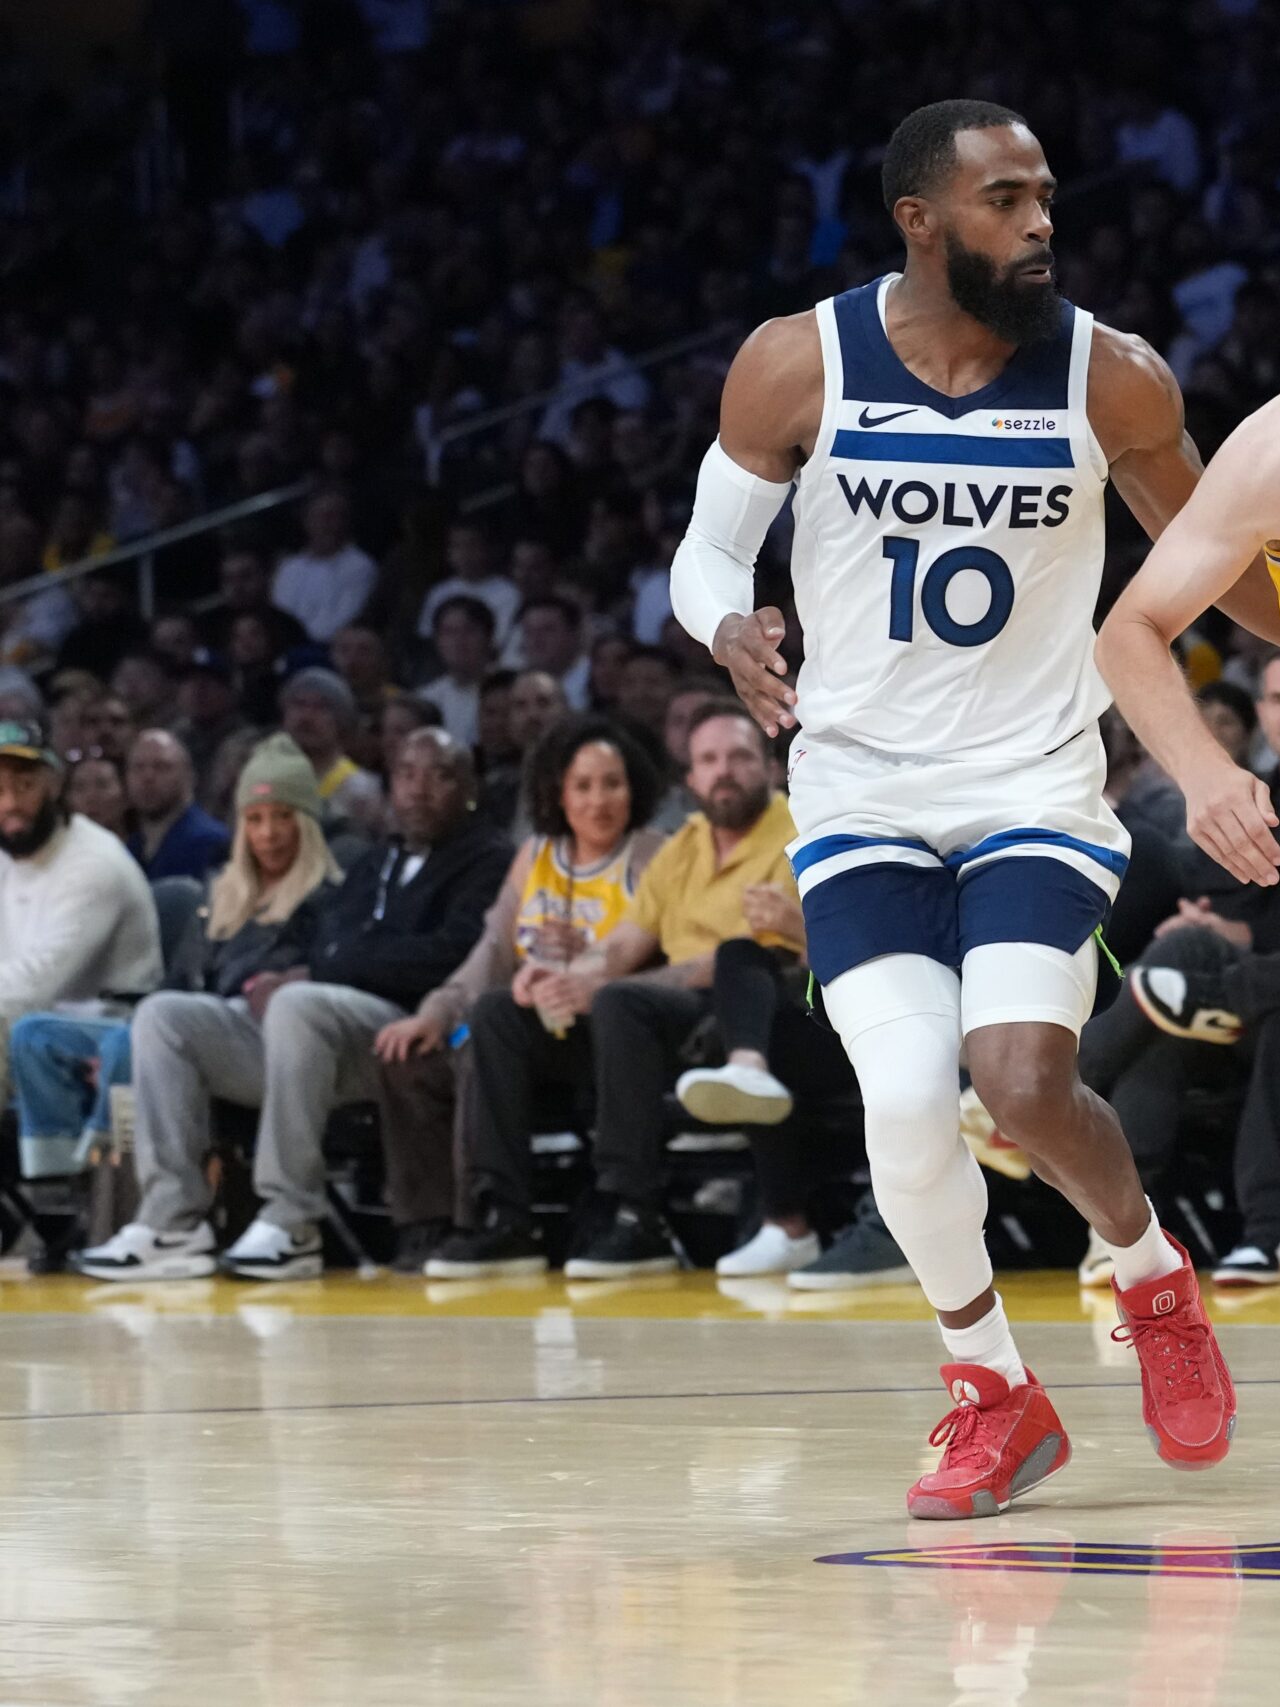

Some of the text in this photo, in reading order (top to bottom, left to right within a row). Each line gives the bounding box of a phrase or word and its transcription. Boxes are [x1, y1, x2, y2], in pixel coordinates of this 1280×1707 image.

[1004, 416, 1056, 431] sezzle
[836, 473, 1074, 529] WOLVES
[882, 535, 1015, 648] 10
